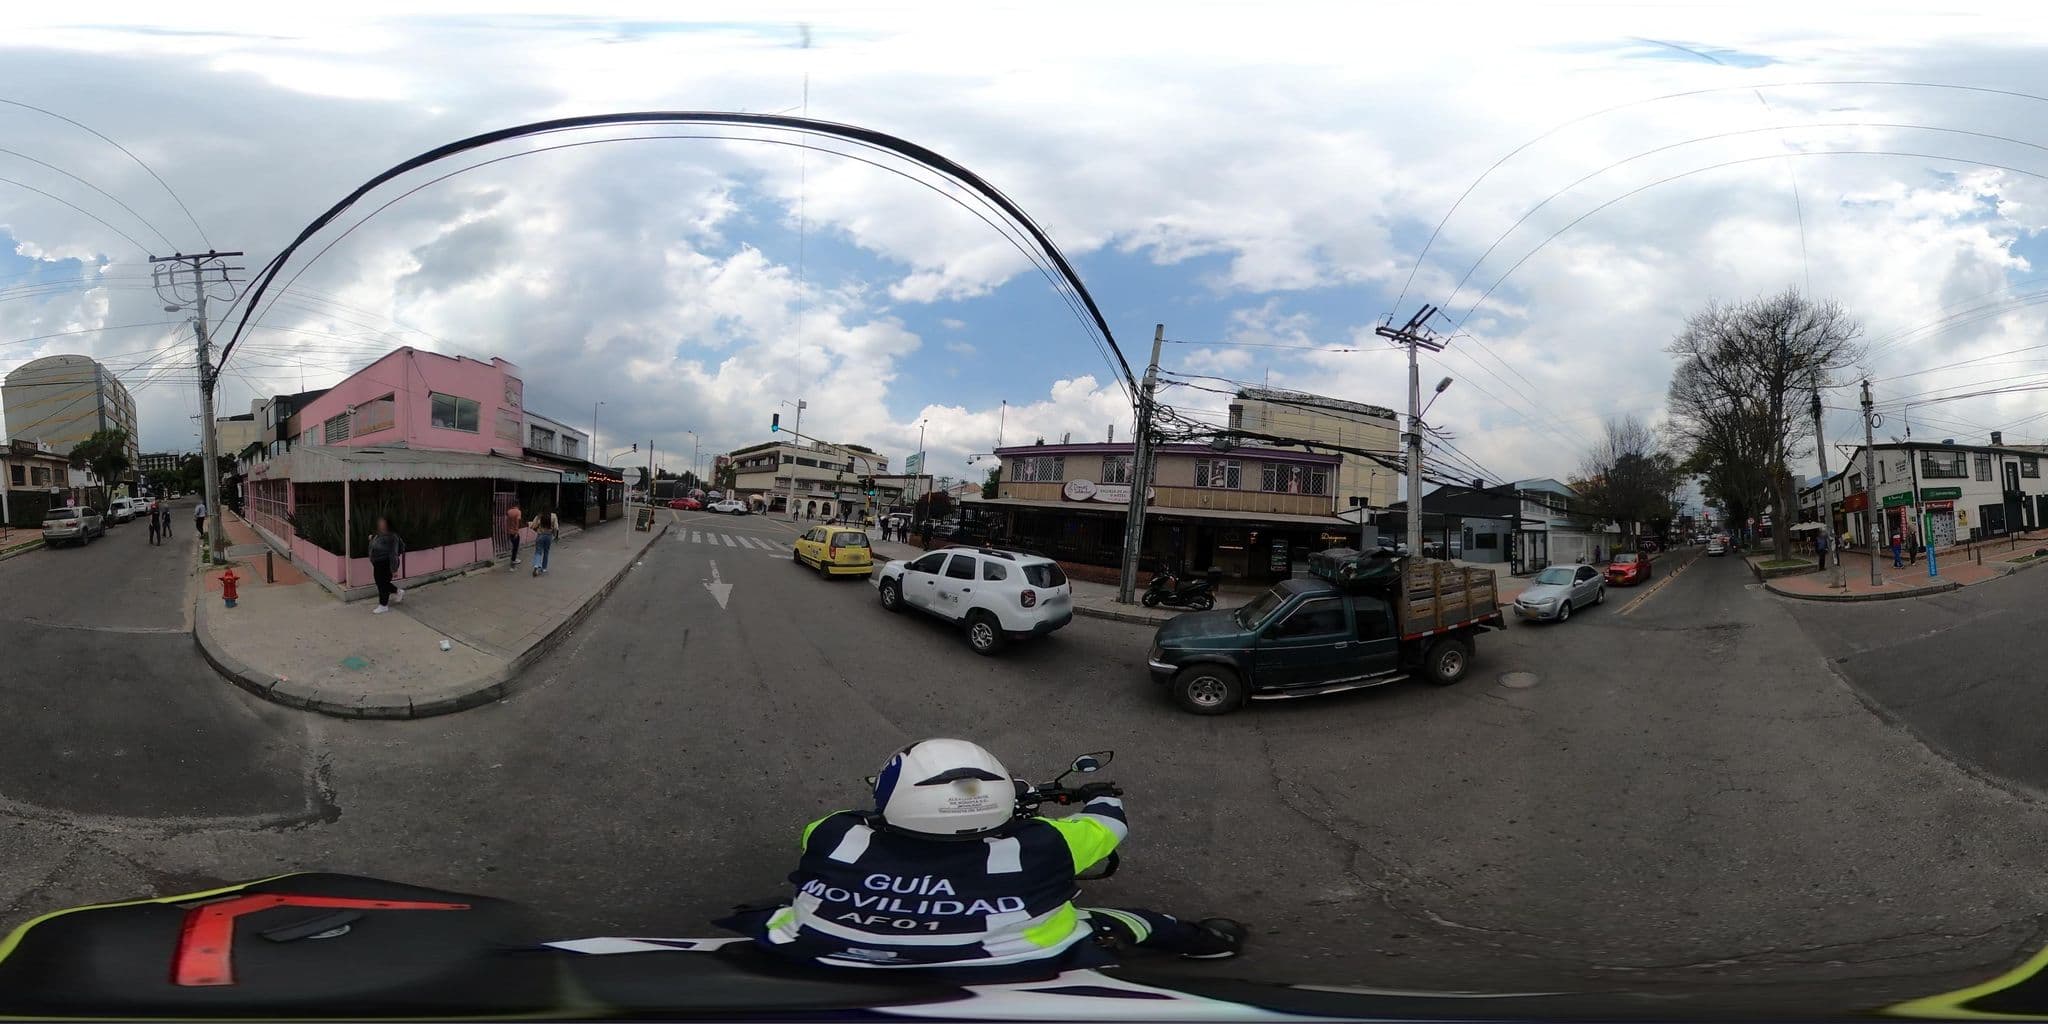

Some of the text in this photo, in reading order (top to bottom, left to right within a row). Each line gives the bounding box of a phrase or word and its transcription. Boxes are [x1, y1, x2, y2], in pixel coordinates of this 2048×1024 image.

[864, 873, 956, 896] GUÍA
[801, 879, 1026, 916] MOVILIDAD
[837, 912, 941, 931] AF01
